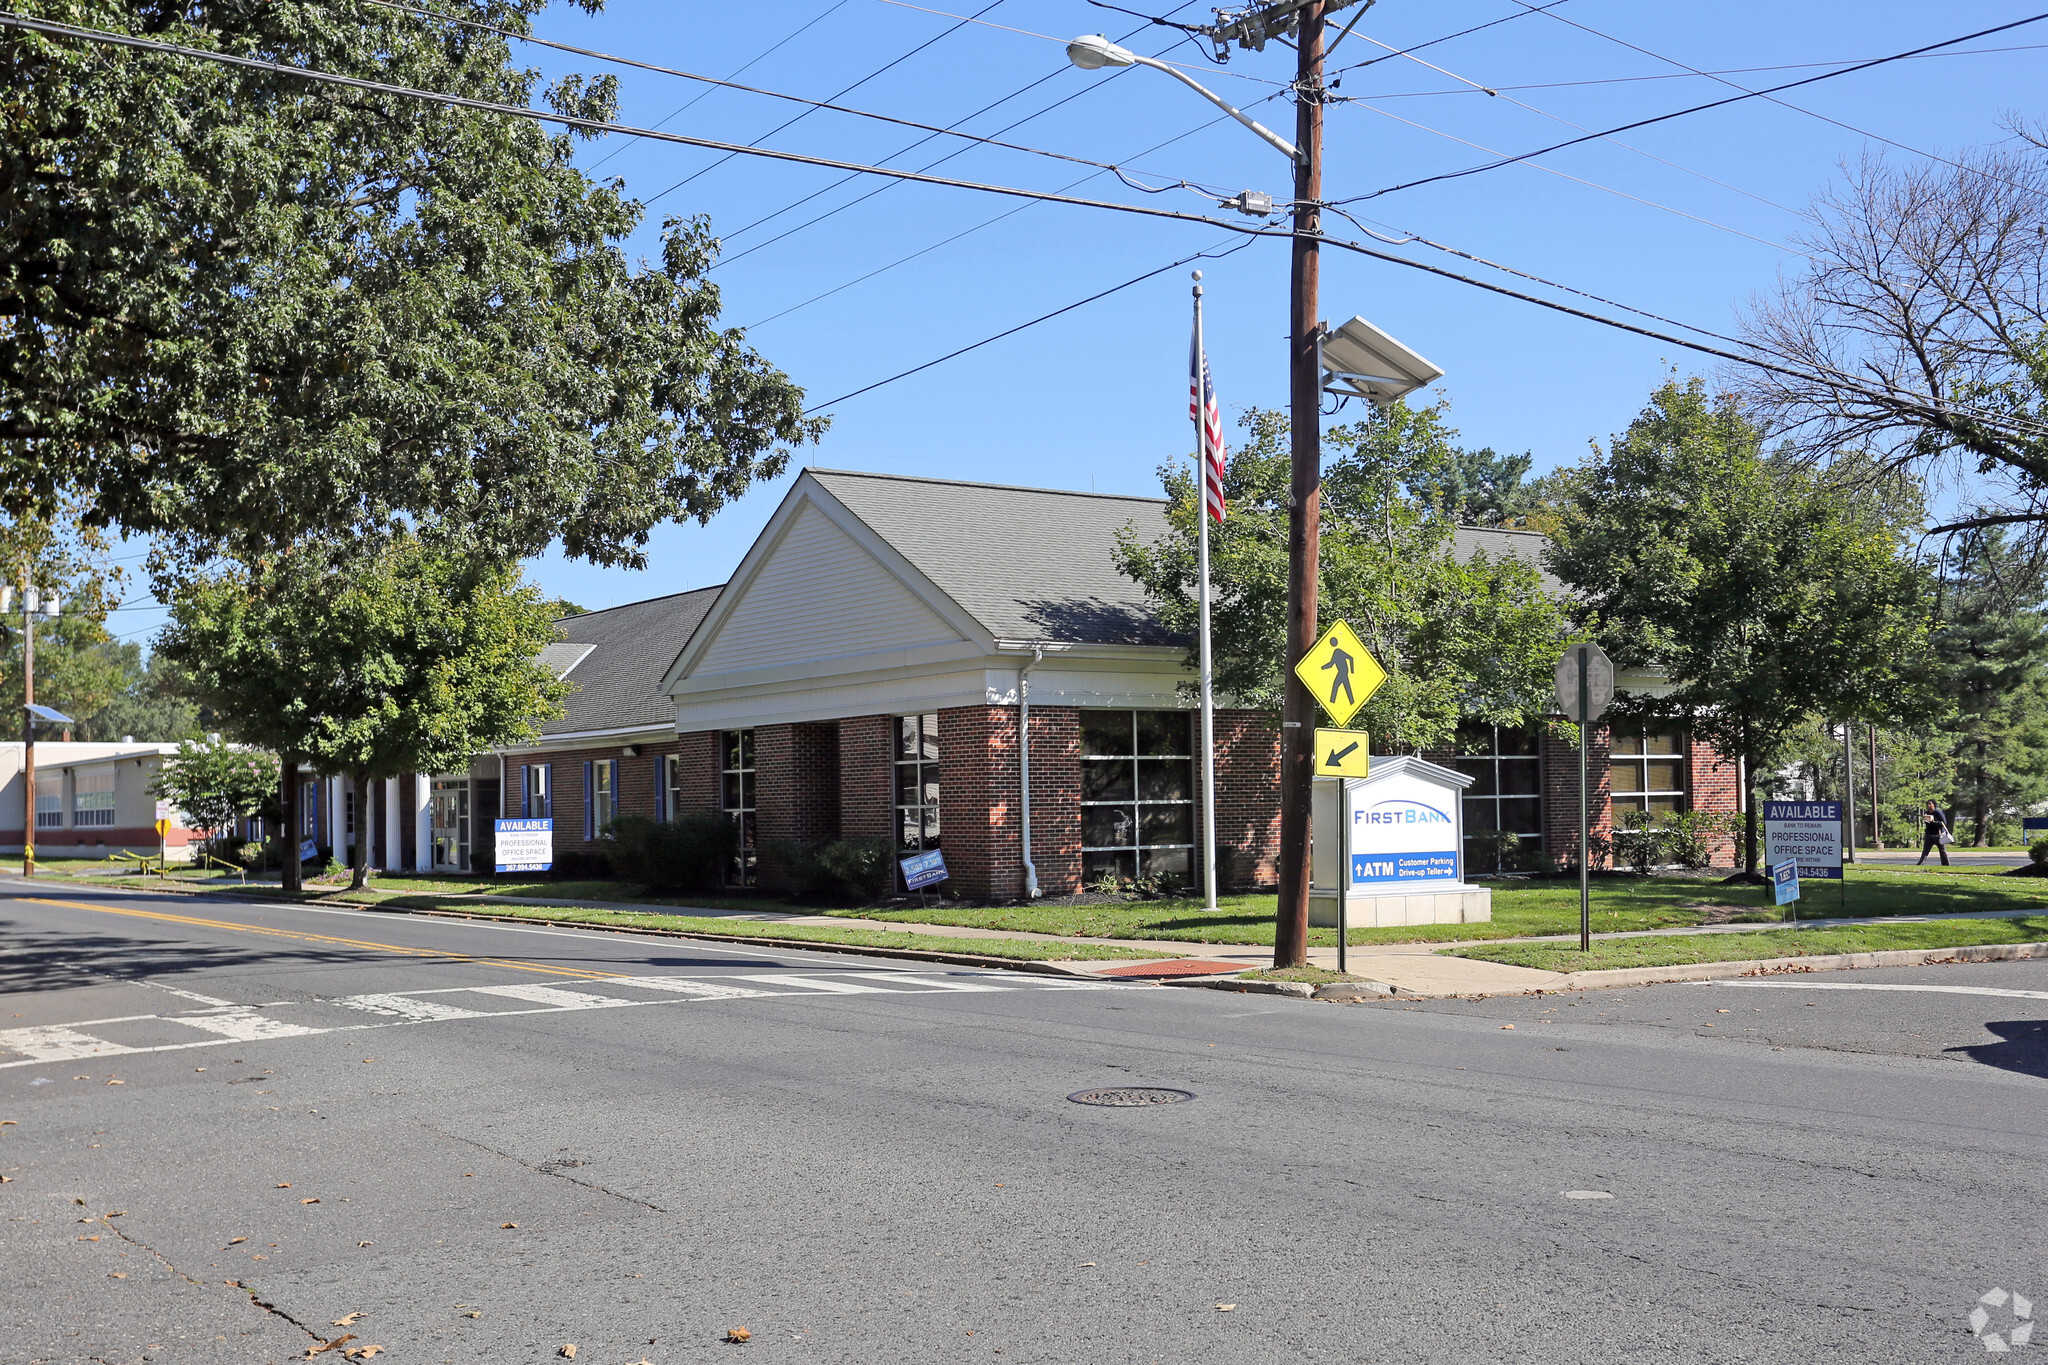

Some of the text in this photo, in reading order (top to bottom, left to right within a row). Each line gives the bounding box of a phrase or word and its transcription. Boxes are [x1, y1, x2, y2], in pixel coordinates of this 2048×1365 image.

[1355, 810, 1450, 824] FIRSTBANK
[1770, 805, 1836, 819] AVAILABLE
[500, 821, 549, 831] AVAILABLE
[1772, 832, 1836, 842] PROFESSIONAL
[500, 839, 548, 847] PROFESSIONAL
[1774, 845, 1834, 856] OFFICE SPACE
[1398, 857, 1454, 867] Customer Parking
[1363, 861, 1394, 877] ATM
[1398, 867, 1444, 878] Drive-up Teller
